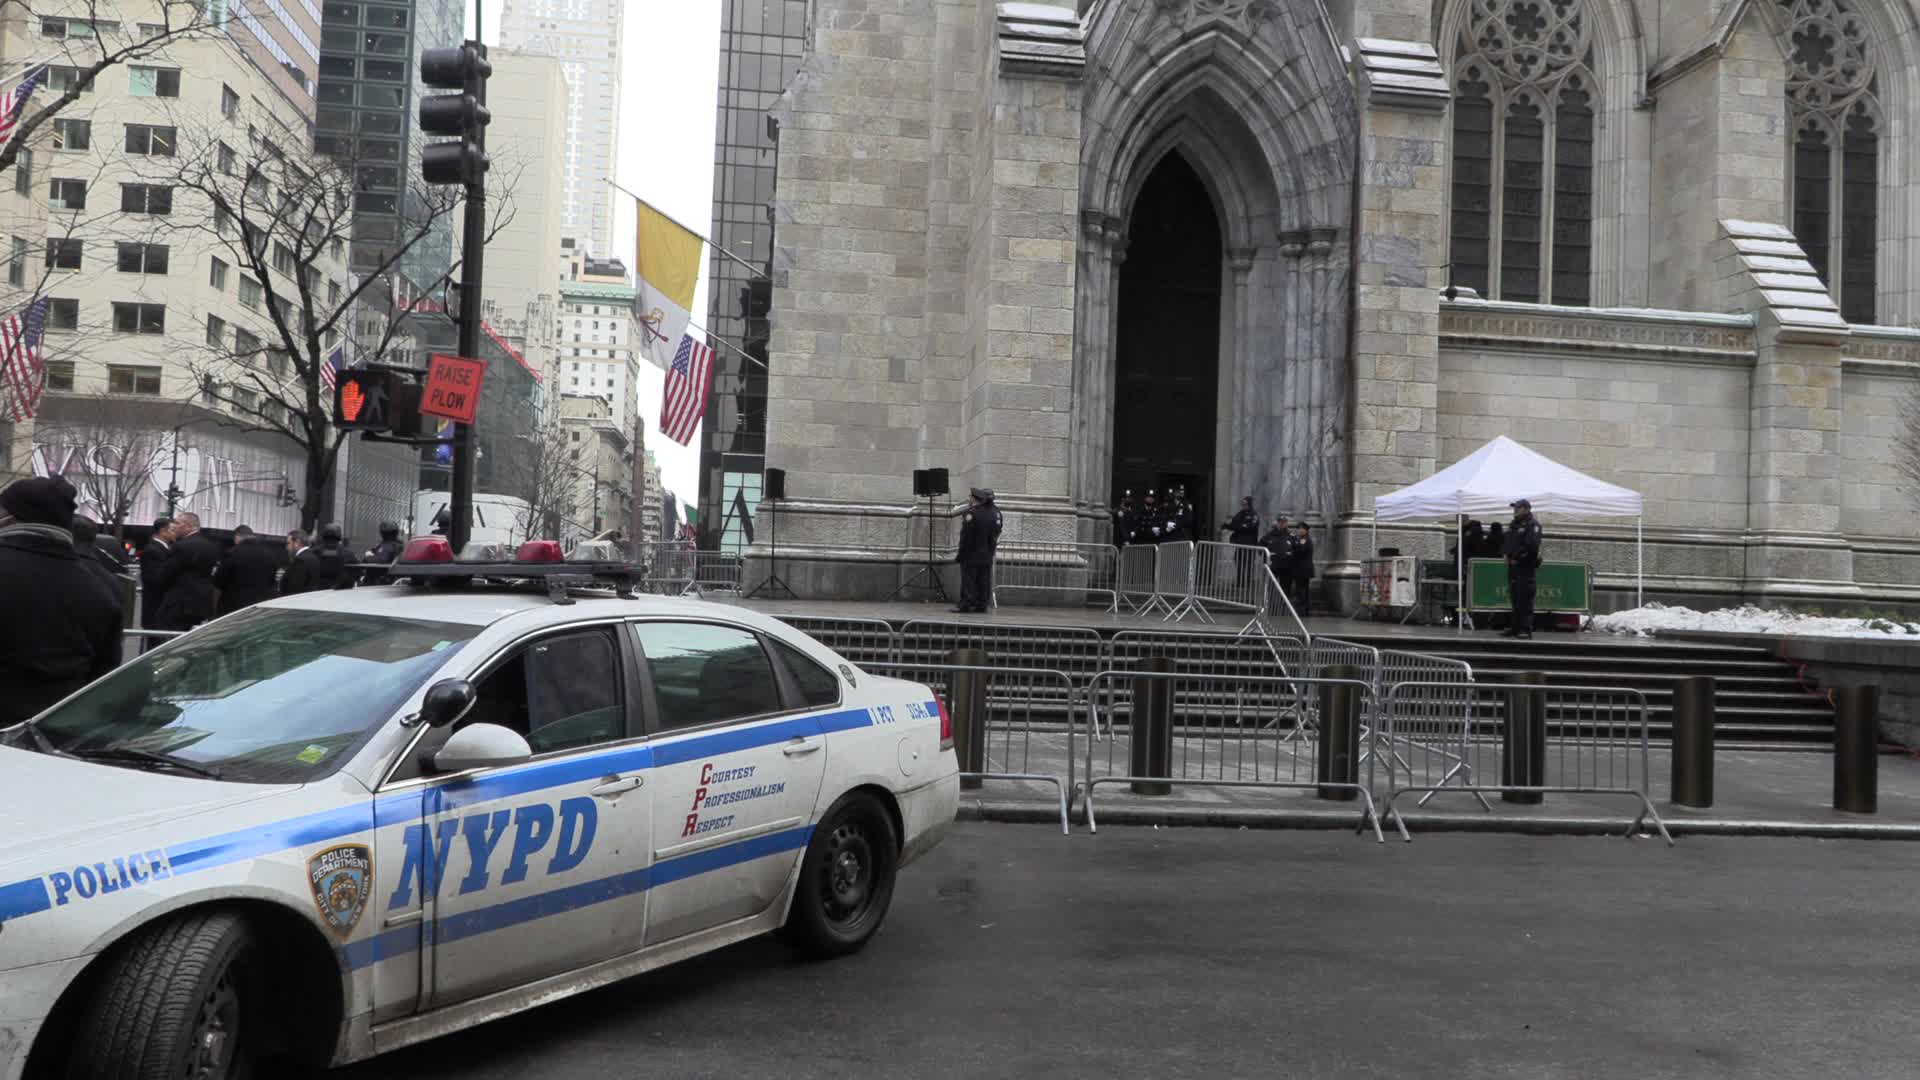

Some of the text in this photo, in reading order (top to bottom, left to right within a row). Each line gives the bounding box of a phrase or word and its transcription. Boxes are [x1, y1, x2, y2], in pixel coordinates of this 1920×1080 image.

[435, 364, 473, 386] RAISE
[429, 388, 466, 410] PLOW
[321, 848, 356, 866] POLICE
[387, 796, 598, 911] NYPD
[49, 849, 170, 906] POLICE
[312, 858, 368, 883] DEPARTMENT
[317, 893, 330, 913] CITY
